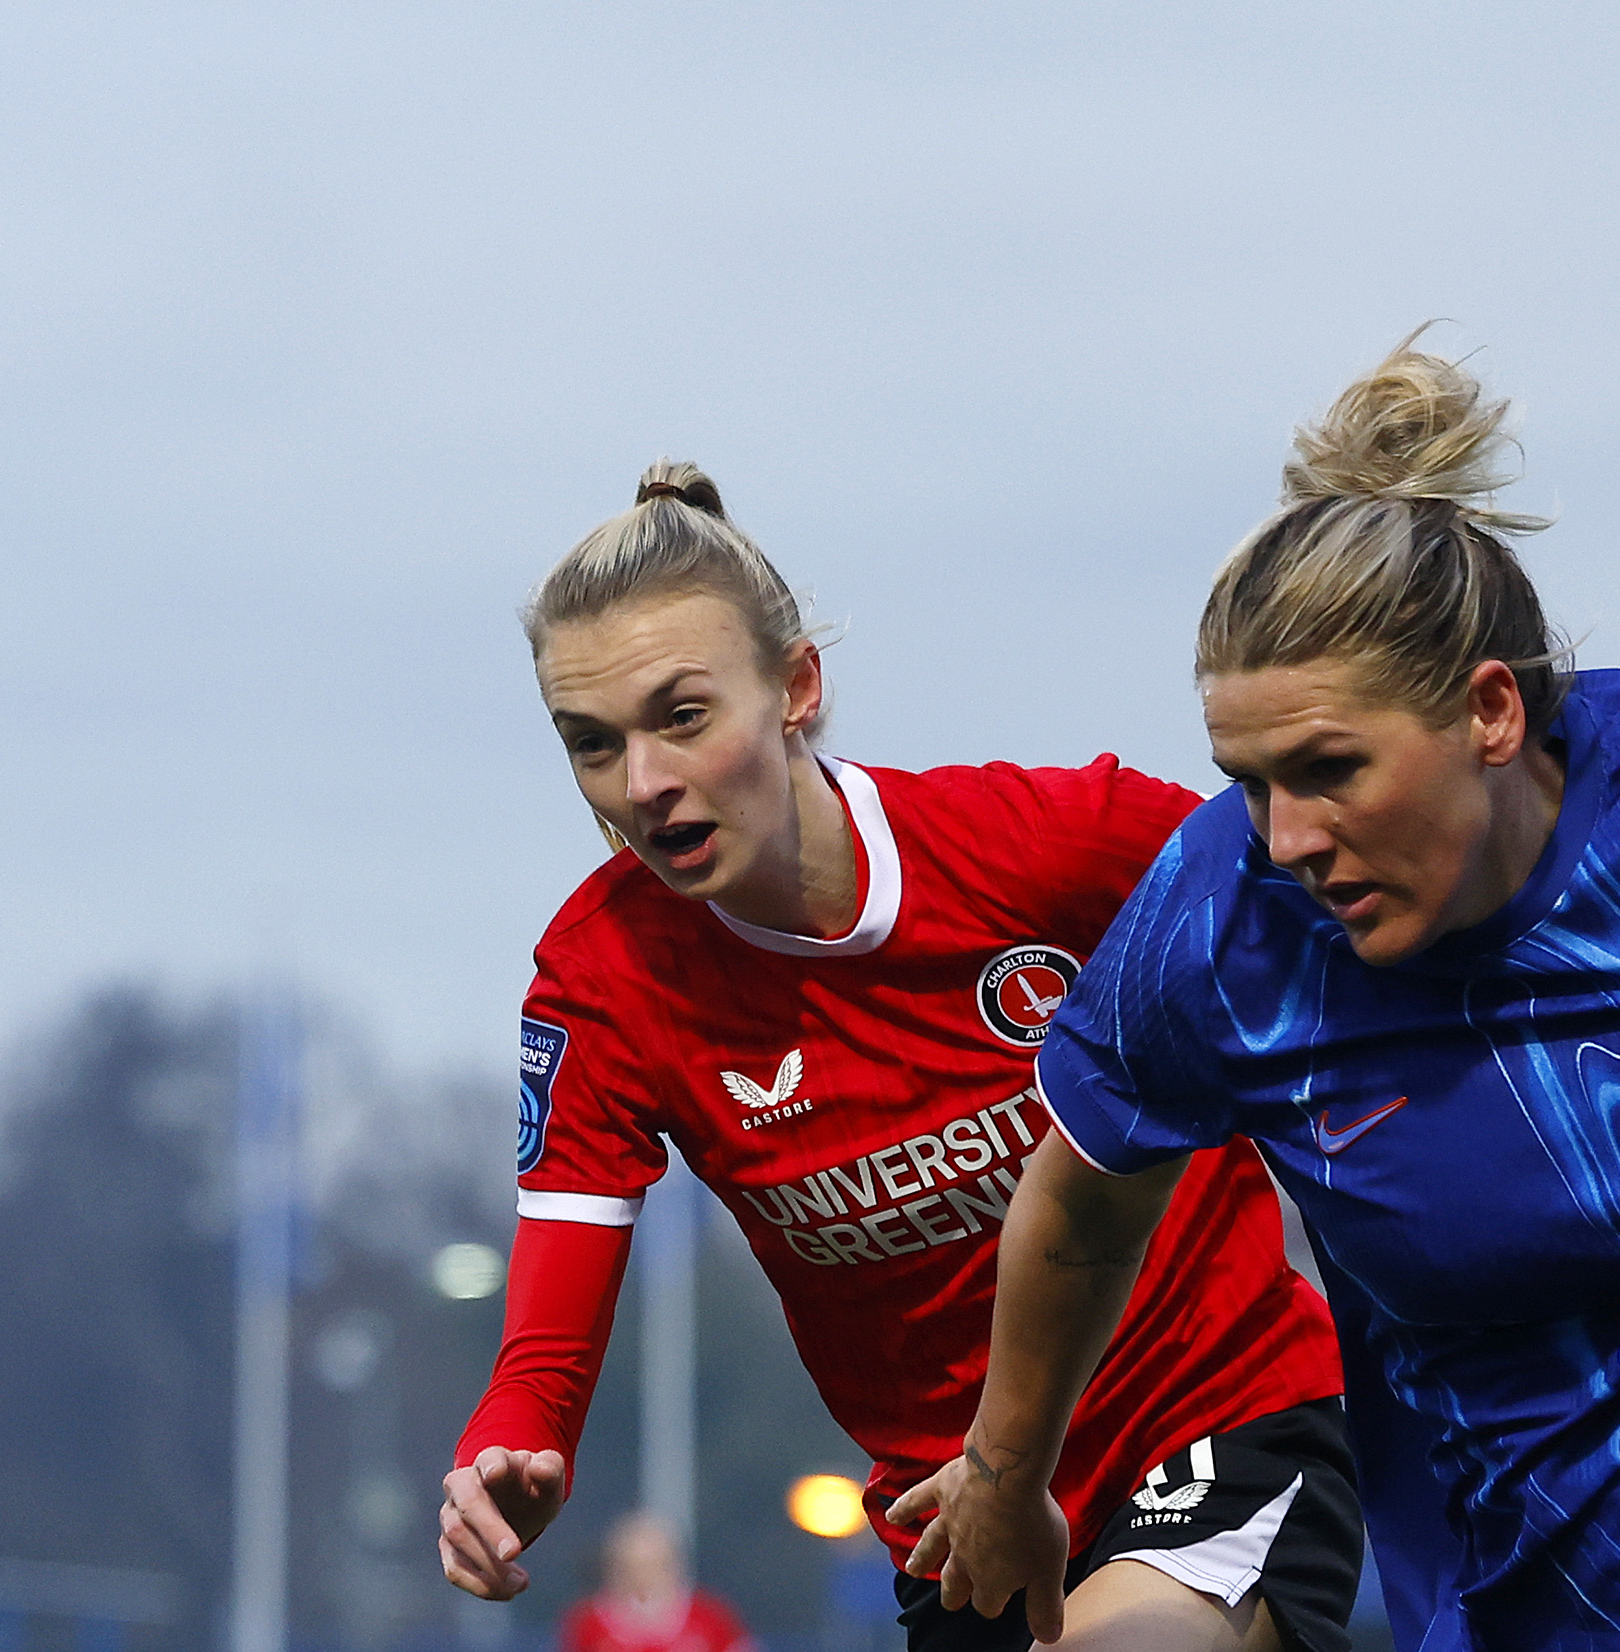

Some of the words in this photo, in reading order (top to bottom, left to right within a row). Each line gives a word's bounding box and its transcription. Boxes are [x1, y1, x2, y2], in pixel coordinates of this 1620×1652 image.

[987, 953, 1046, 988] CHARLTON
[522, 1031, 557, 1052] CLAYS
[1025, 1025, 1050, 1040] ATH
[522, 1046, 551, 1067] EN'S
[741, 1098, 813, 1131] CASTORE
[782, 1153, 1034, 1266] GREEN
